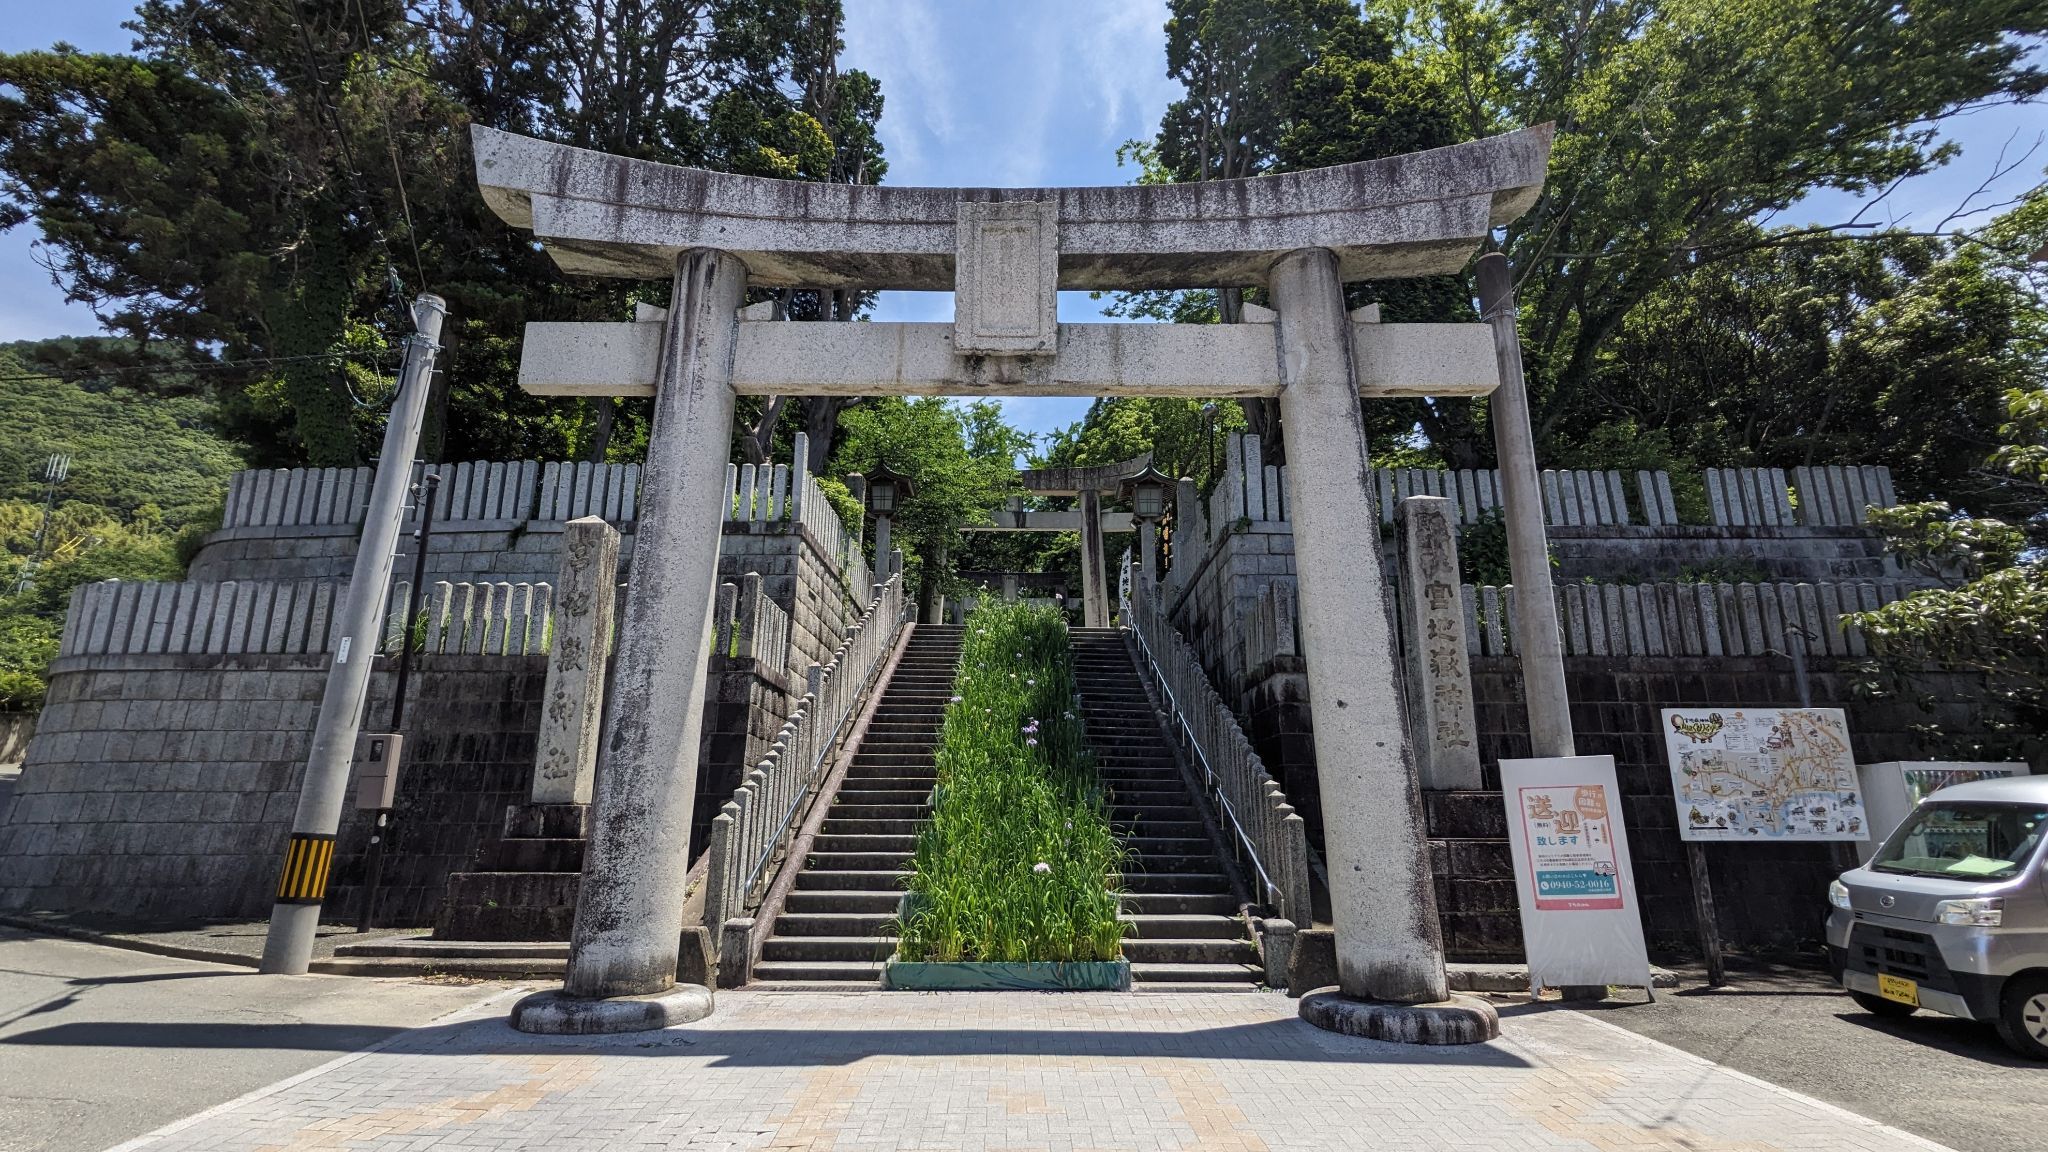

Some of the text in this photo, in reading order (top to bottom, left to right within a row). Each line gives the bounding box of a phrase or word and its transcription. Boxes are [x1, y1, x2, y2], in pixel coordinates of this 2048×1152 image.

[1527, 794, 1581, 834] 送迎
[1536, 835, 1578, 846] 致します
[1550, 880, 1610, 889] 0940-52-0016
